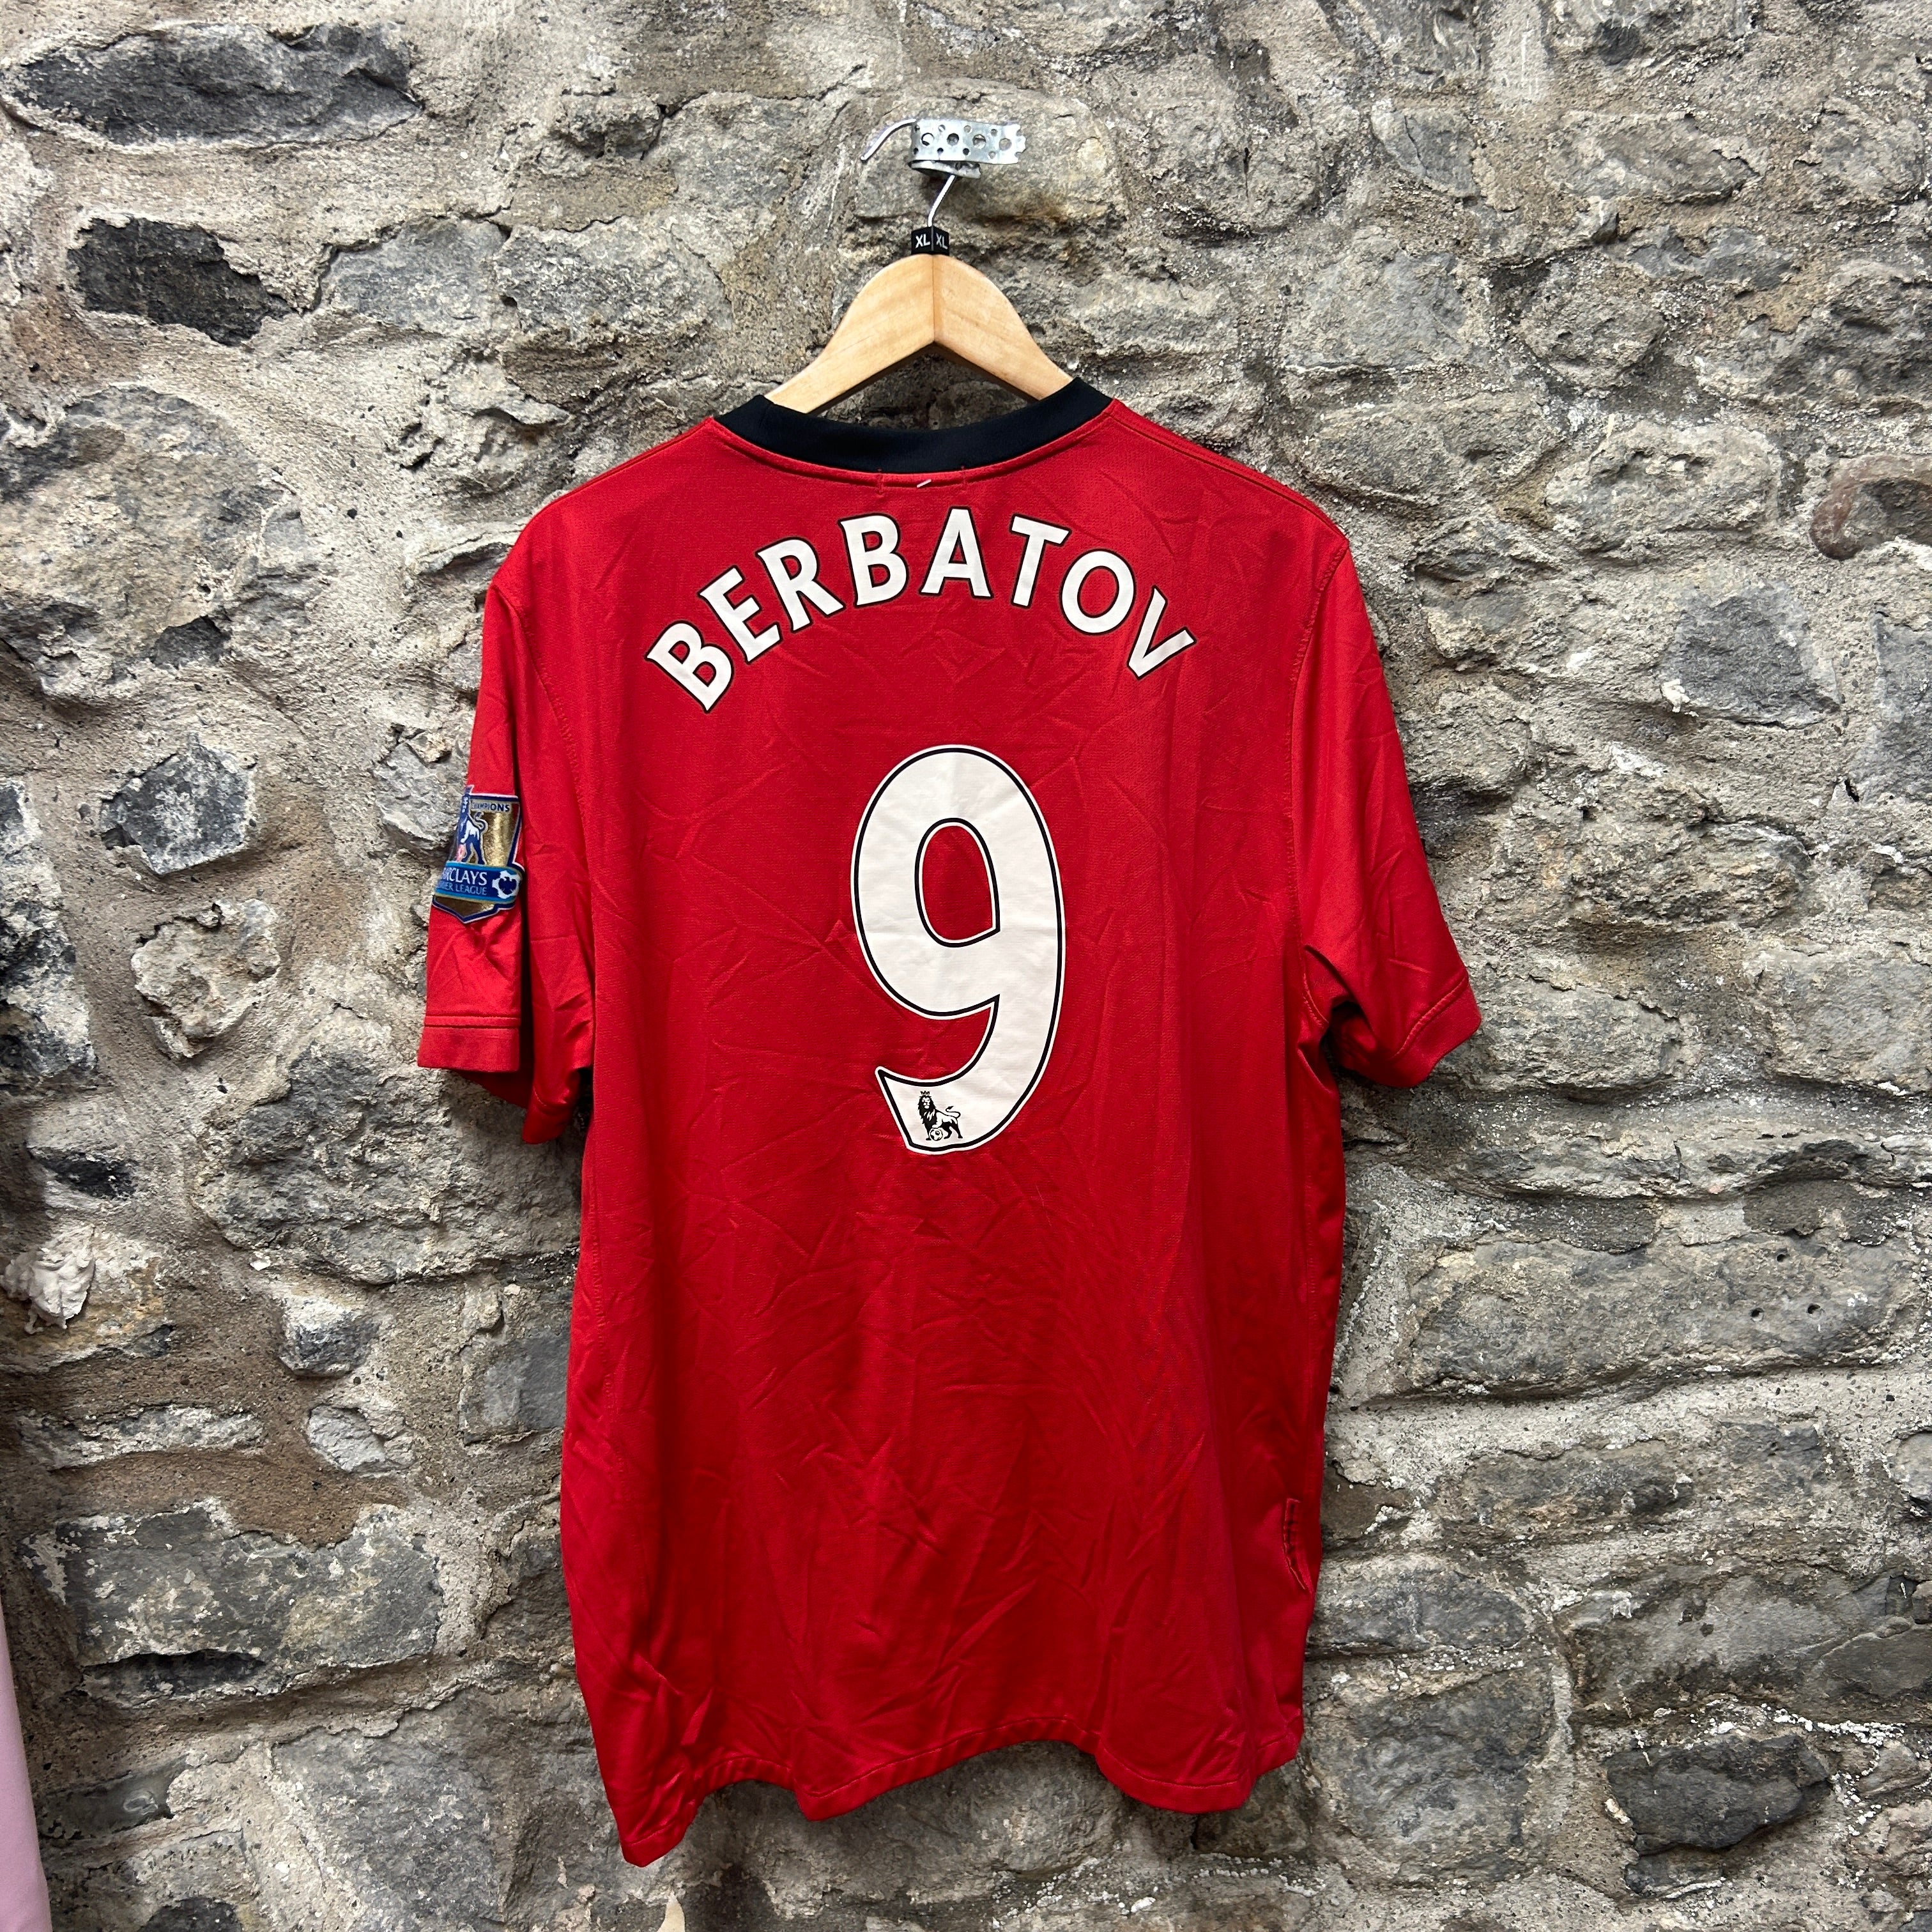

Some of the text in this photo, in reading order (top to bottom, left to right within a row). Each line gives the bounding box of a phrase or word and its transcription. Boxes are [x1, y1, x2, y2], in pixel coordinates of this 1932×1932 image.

[915, 234, 931, 249] XL
[935, 233, 948, 249] XL
[646, 507, 1196, 712] BERBATOV
[456, 884, 487, 895] LEAGUE
[850, 744, 1066, 1155] 9
